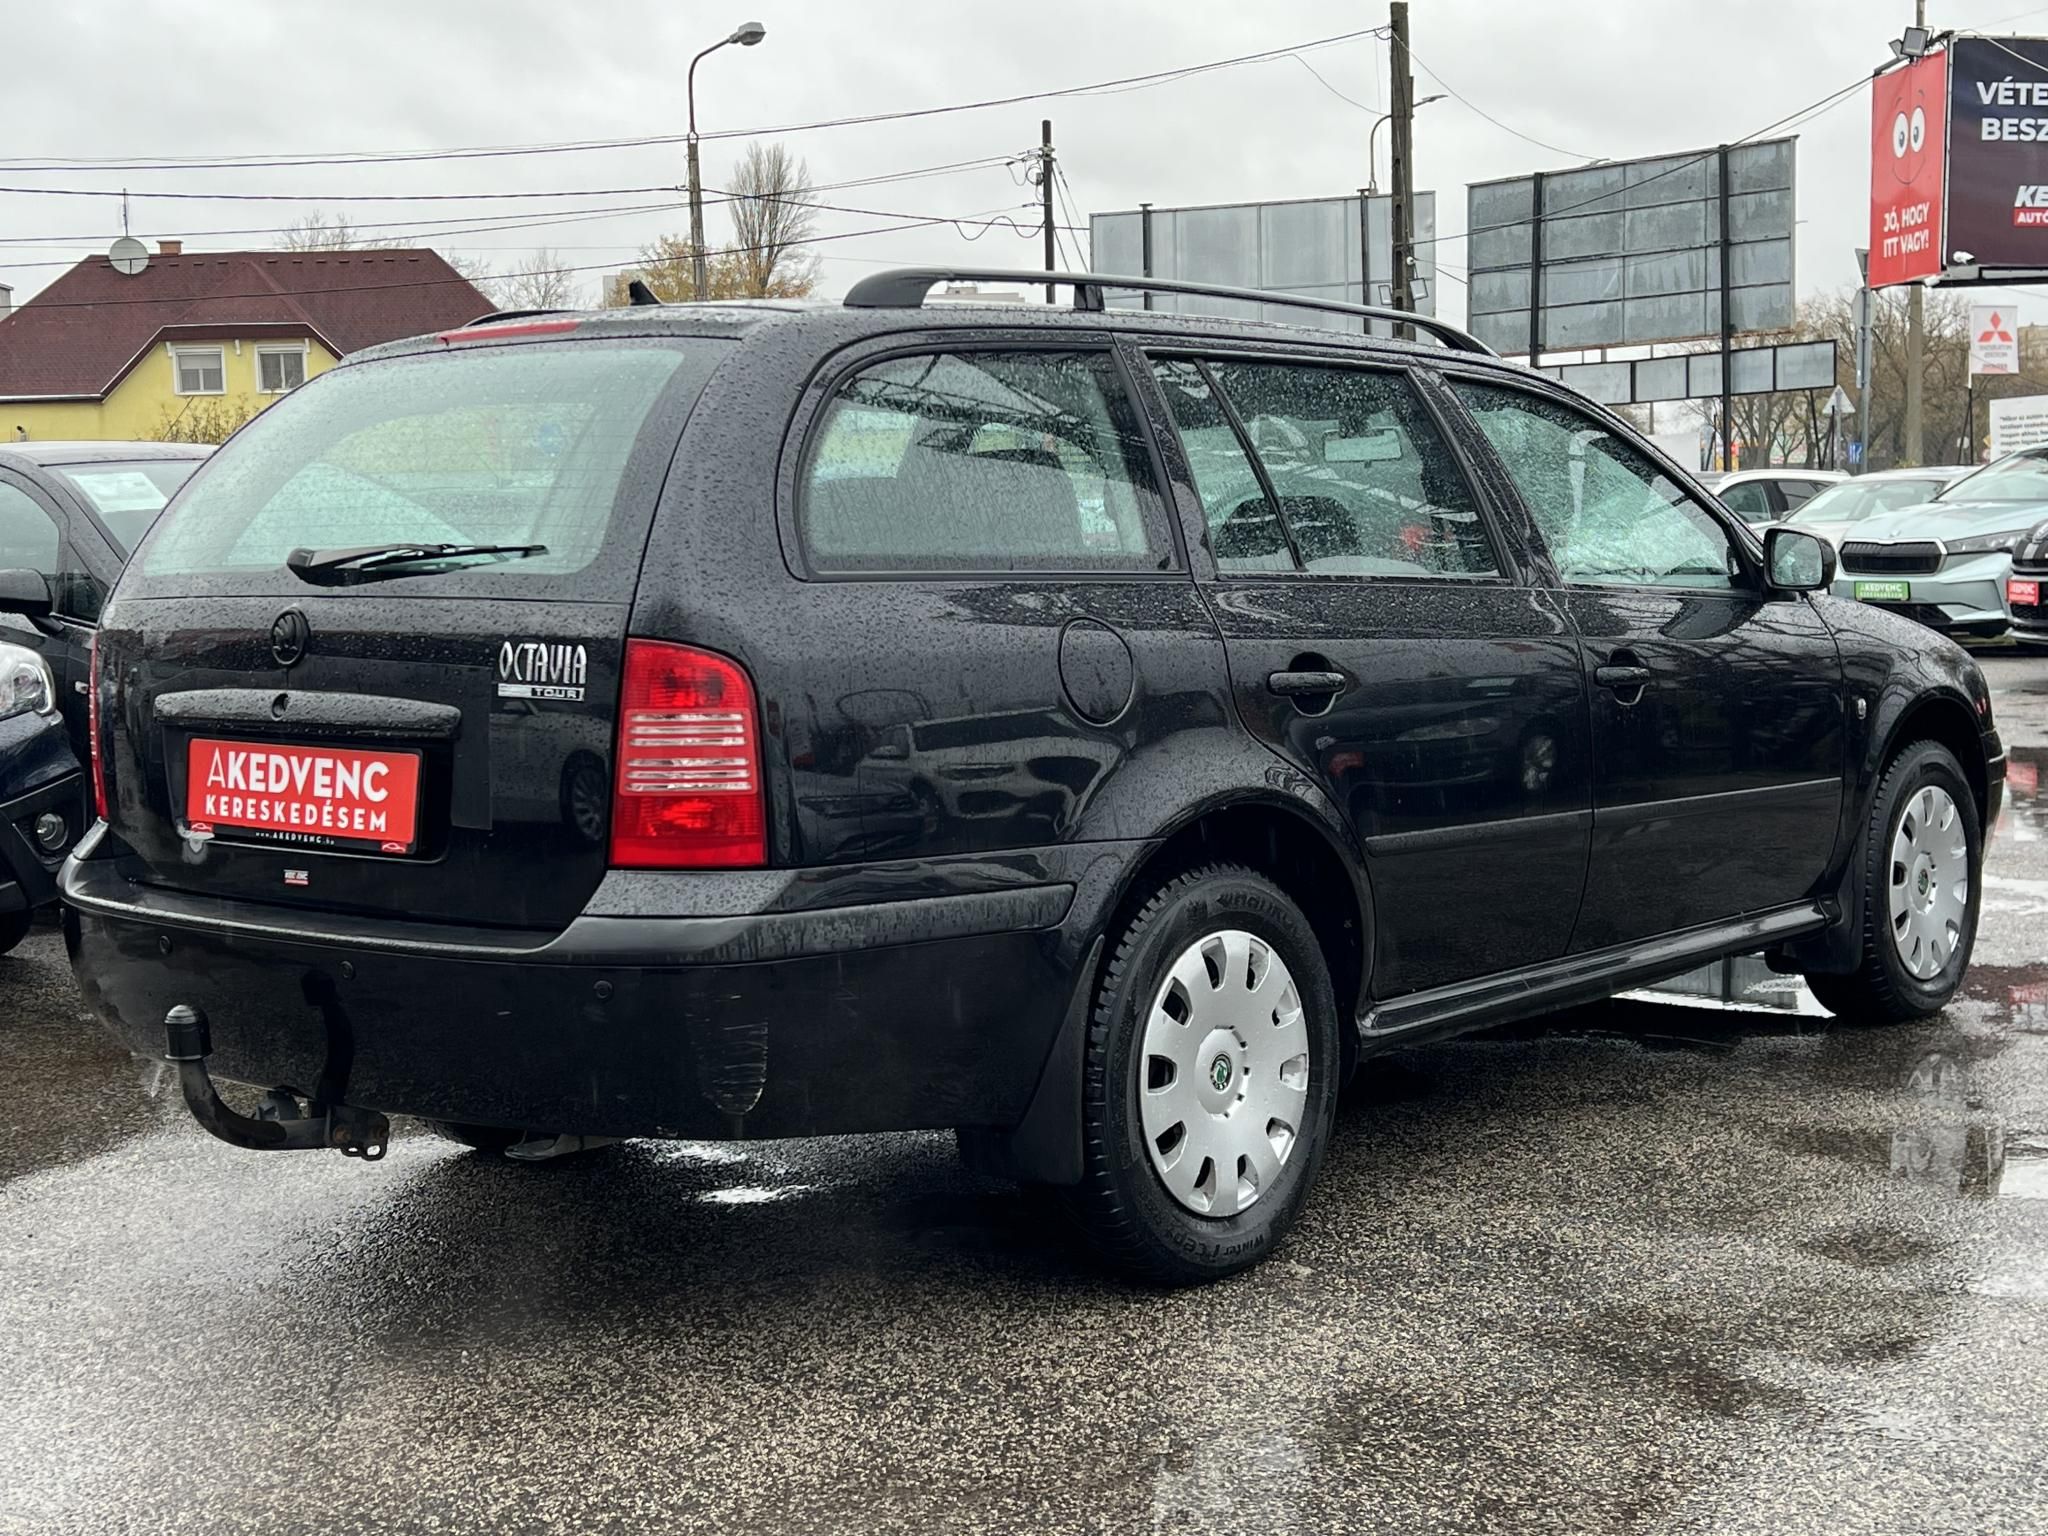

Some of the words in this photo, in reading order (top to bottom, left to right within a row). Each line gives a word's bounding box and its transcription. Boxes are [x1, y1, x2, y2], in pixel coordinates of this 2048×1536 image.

[1883, 205, 1900, 233] JÓ,
[1901, 201, 1930, 228] HOGY
[1883, 236, 1899, 258] ITT
[1900, 228, 1930, 254] VAGY!
[499, 641, 588, 684] OCTAVIA
[534, 687, 578, 699] TOUR
[206, 746, 390, 803] AKEDVENC
[205, 793, 387, 833] KERESKEDÉSEM
